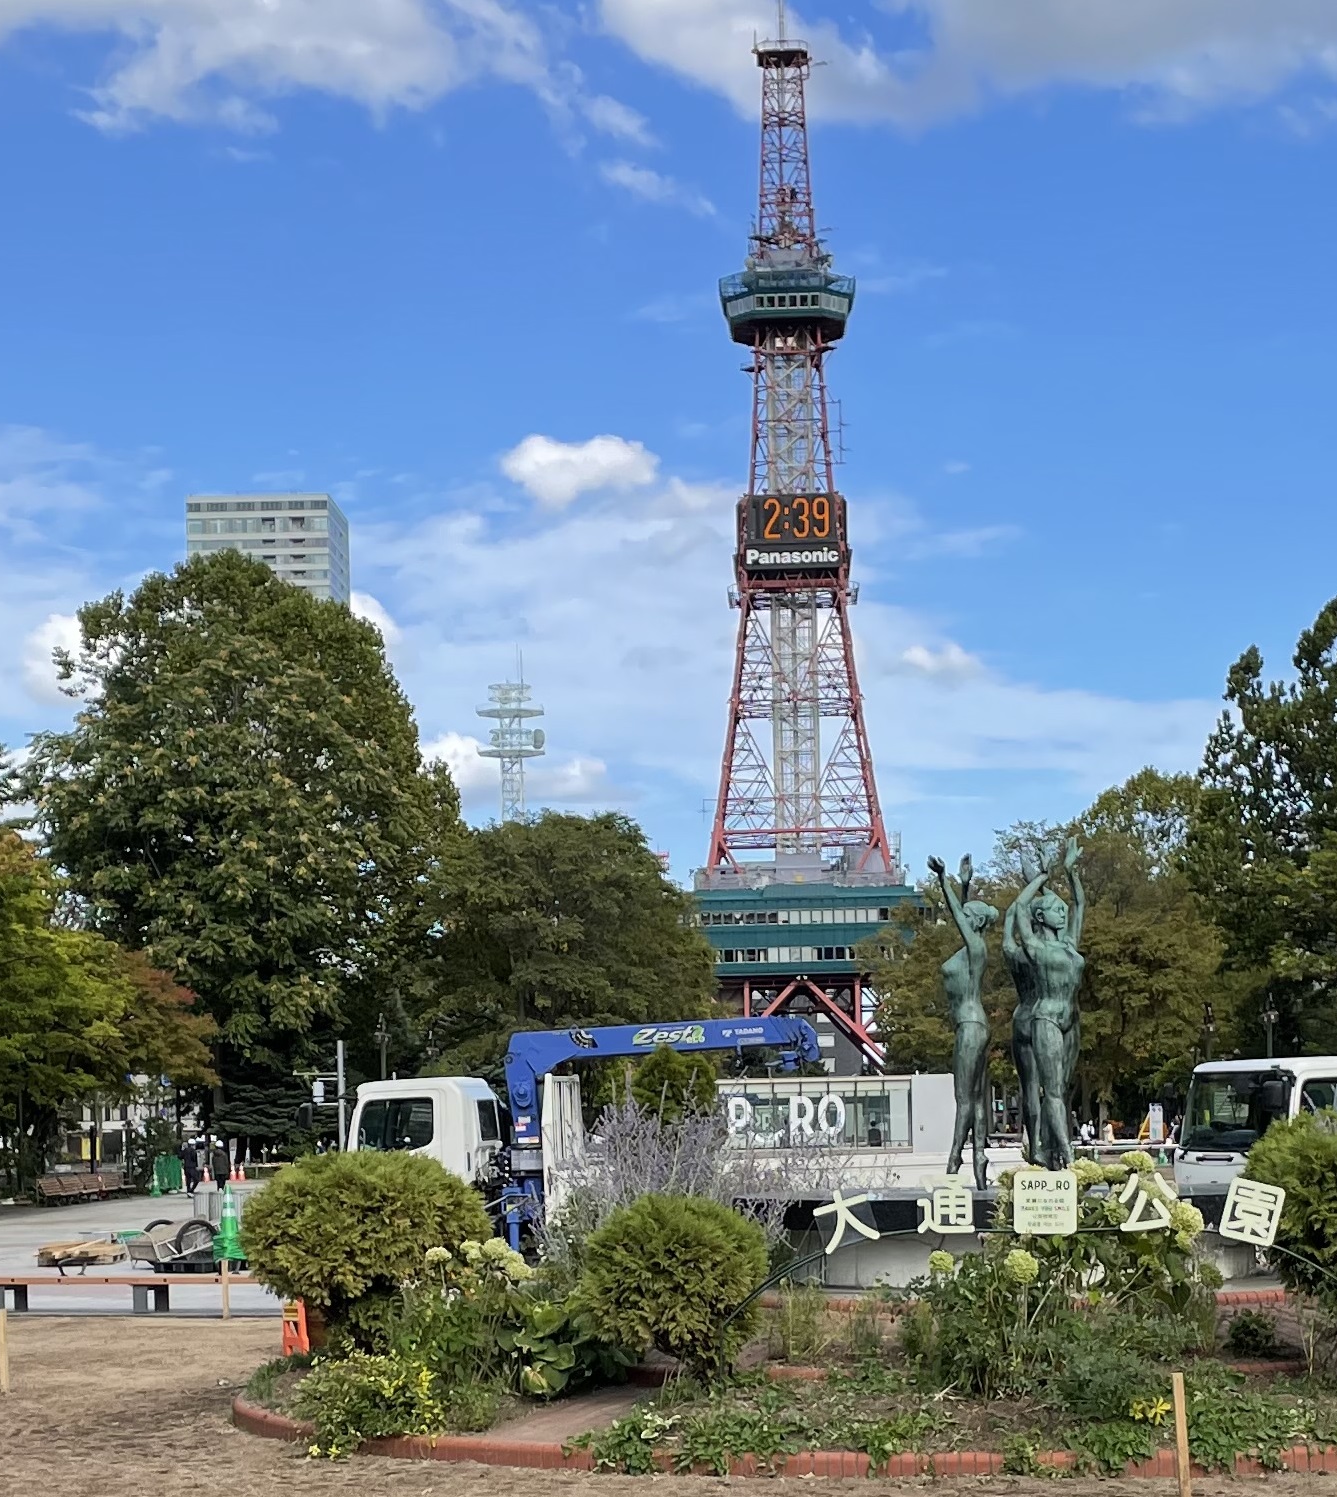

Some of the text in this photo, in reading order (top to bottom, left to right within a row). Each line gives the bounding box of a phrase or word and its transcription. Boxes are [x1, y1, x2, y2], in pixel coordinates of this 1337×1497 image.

[763, 497, 830, 541] 2:39
[746, 547, 839, 565] Panasonic
[632, 1025, 694, 1045] Zest
